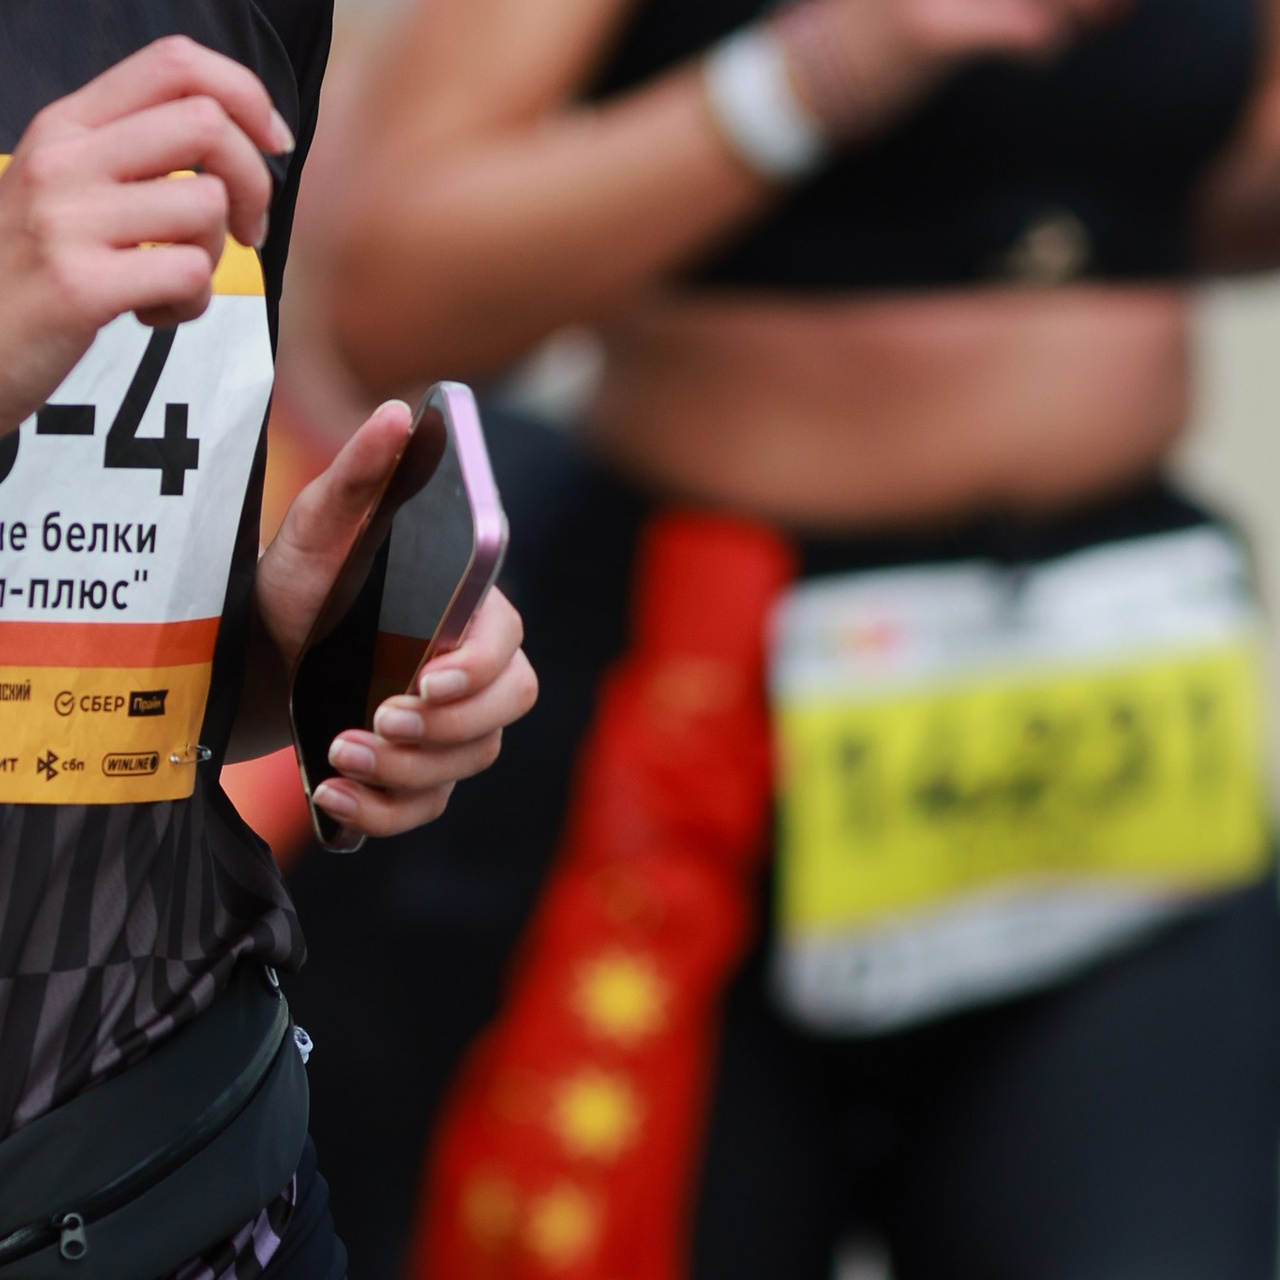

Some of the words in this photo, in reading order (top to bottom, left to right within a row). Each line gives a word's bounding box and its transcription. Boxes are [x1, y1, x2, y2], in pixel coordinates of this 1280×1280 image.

[41, 511, 157, 553] белки
[80, 695, 125, 712] СБЕР
[107, 757, 150, 772] WINLINE
